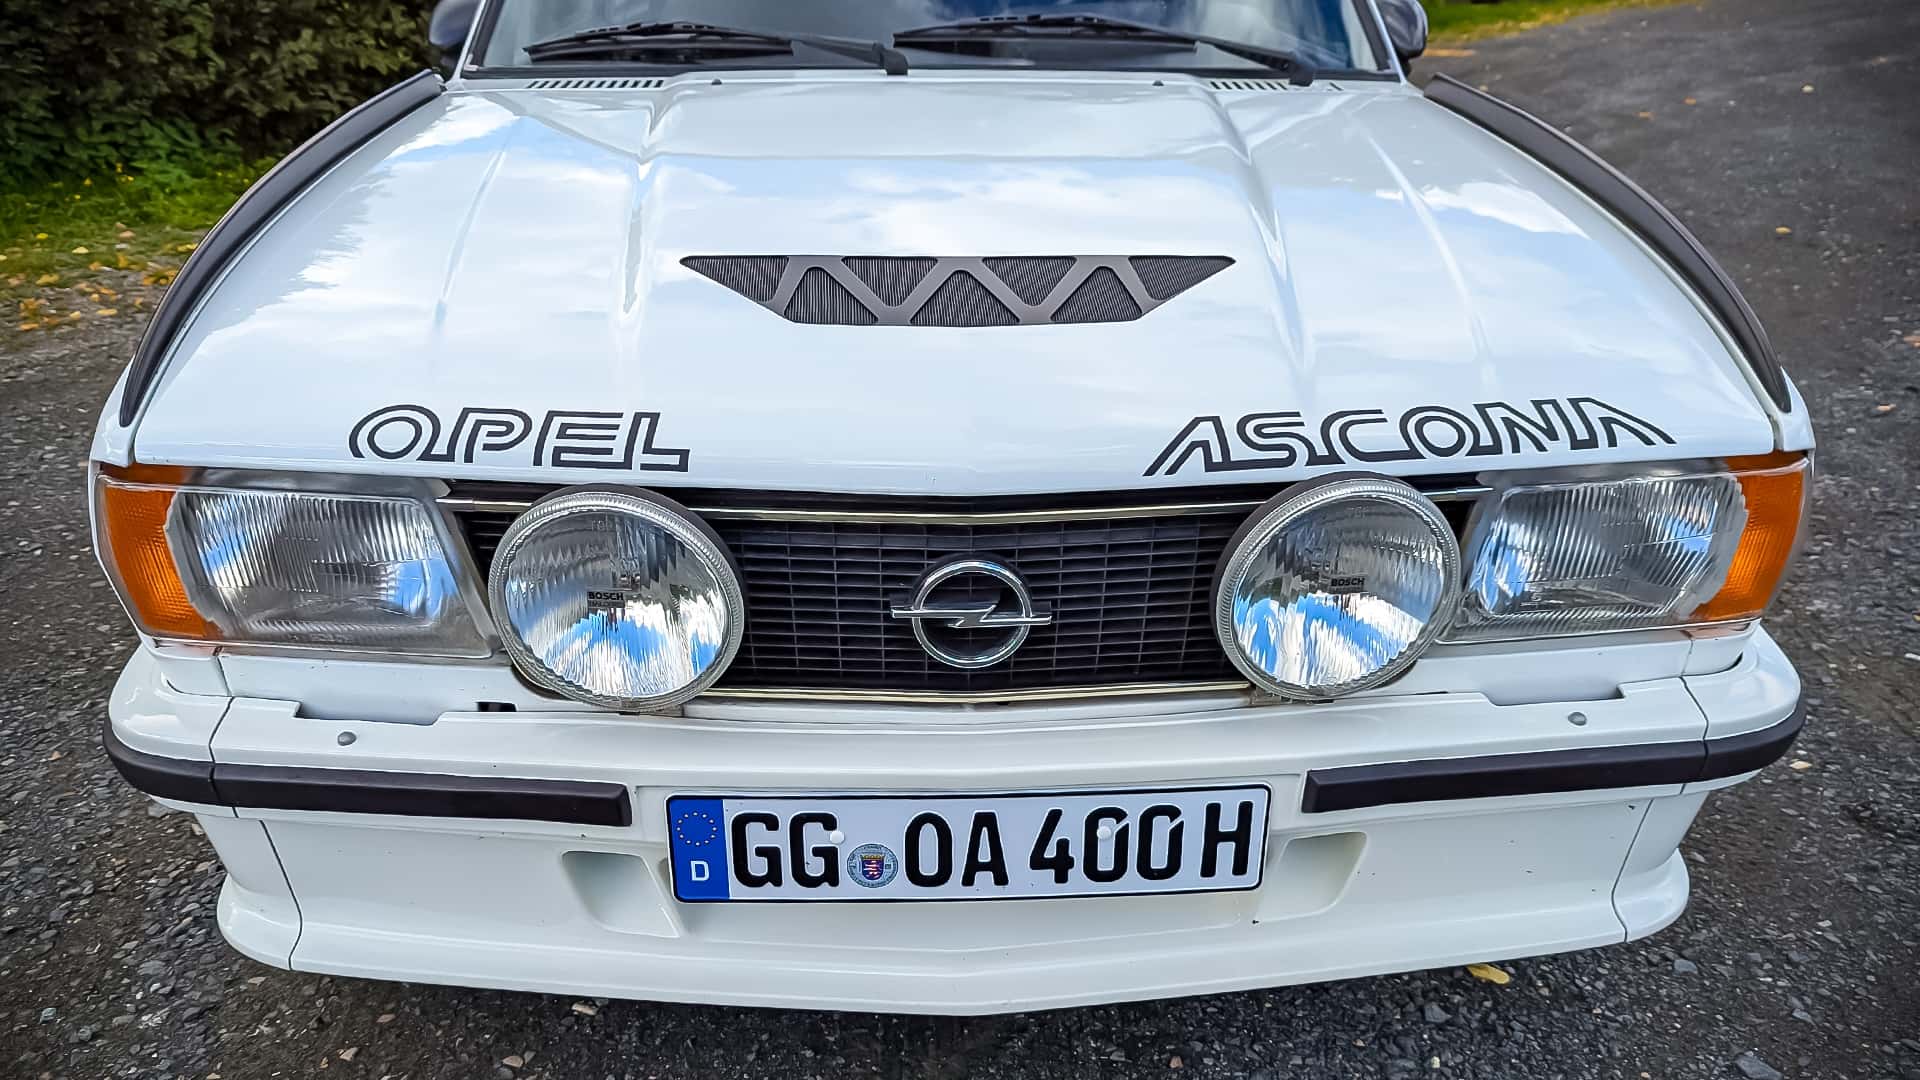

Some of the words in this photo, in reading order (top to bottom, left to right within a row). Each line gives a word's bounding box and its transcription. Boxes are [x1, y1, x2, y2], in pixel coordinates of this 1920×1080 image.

[348, 403, 691, 473] OPEL
[1142, 396, 1677, 477] ASCONA
[588, 591, 624, 600] BOSCH
[1331, 577, 1365, 587] BOSCH
[690, 860, 710, 881] D
[731, 812, 840, 889] GG
[904, 811, 1010, 888] OA
